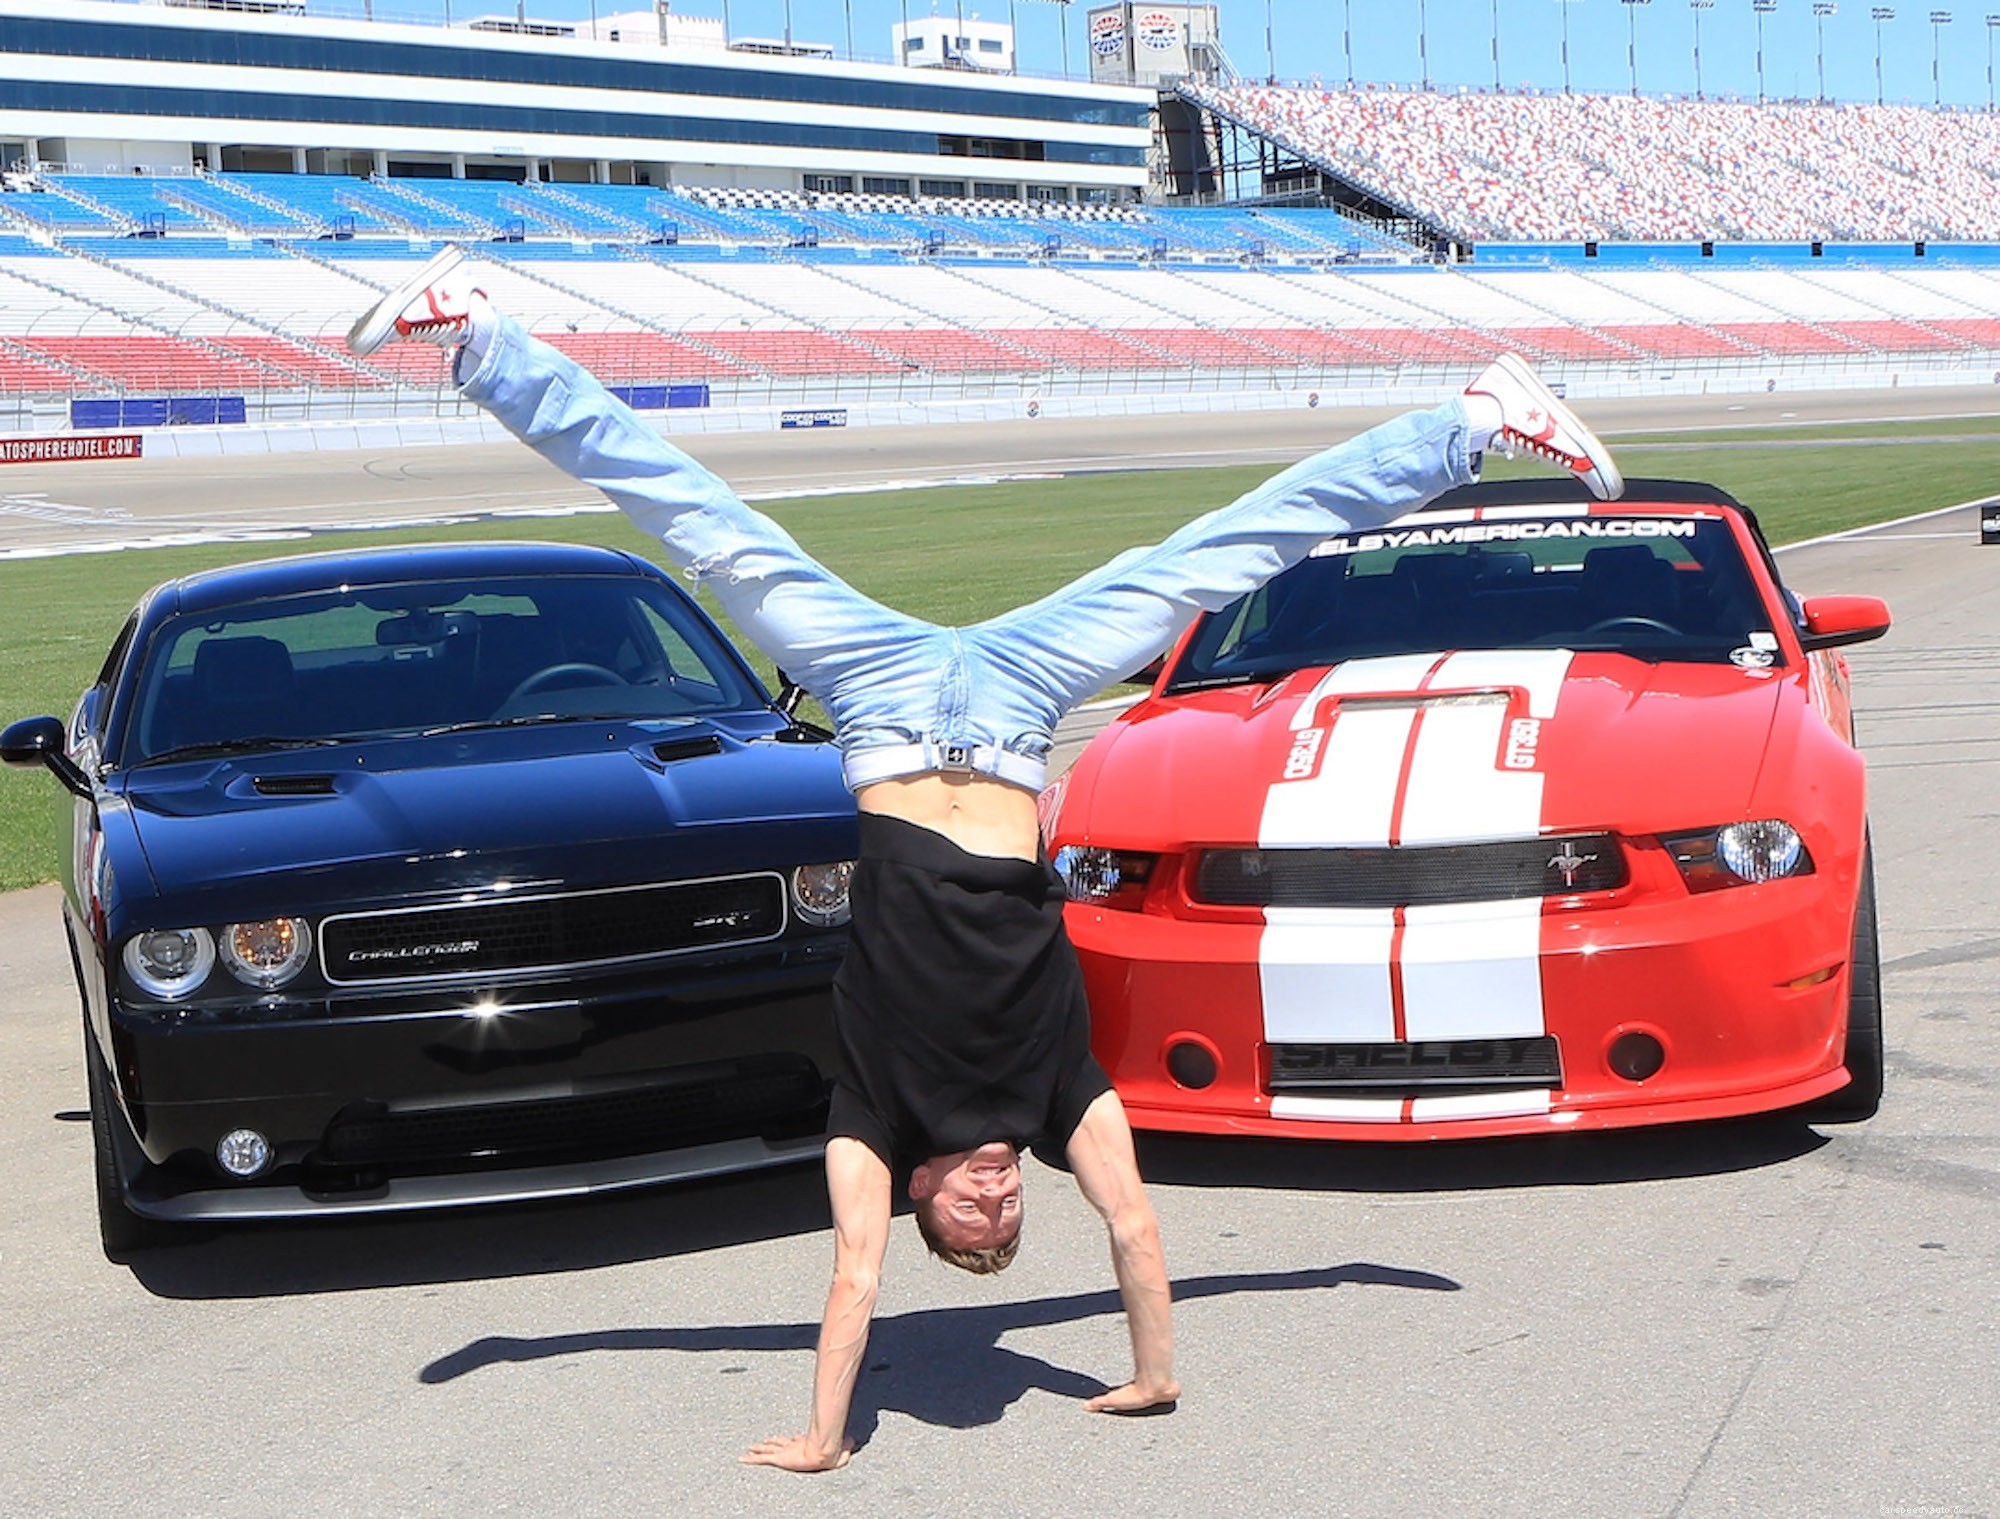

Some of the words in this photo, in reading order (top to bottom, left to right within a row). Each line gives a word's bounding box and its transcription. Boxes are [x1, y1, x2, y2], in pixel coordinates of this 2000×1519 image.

[1308, 520, 1696, 560] ELBYAMERICAN.COM
[1283, 726, 1326, 780] GT350
[1505, 717, 1542, 769] GT350
[348, 940, 480, 961] CHALLENGER
[1278, 1040, 1534, 1070] SHELBY
